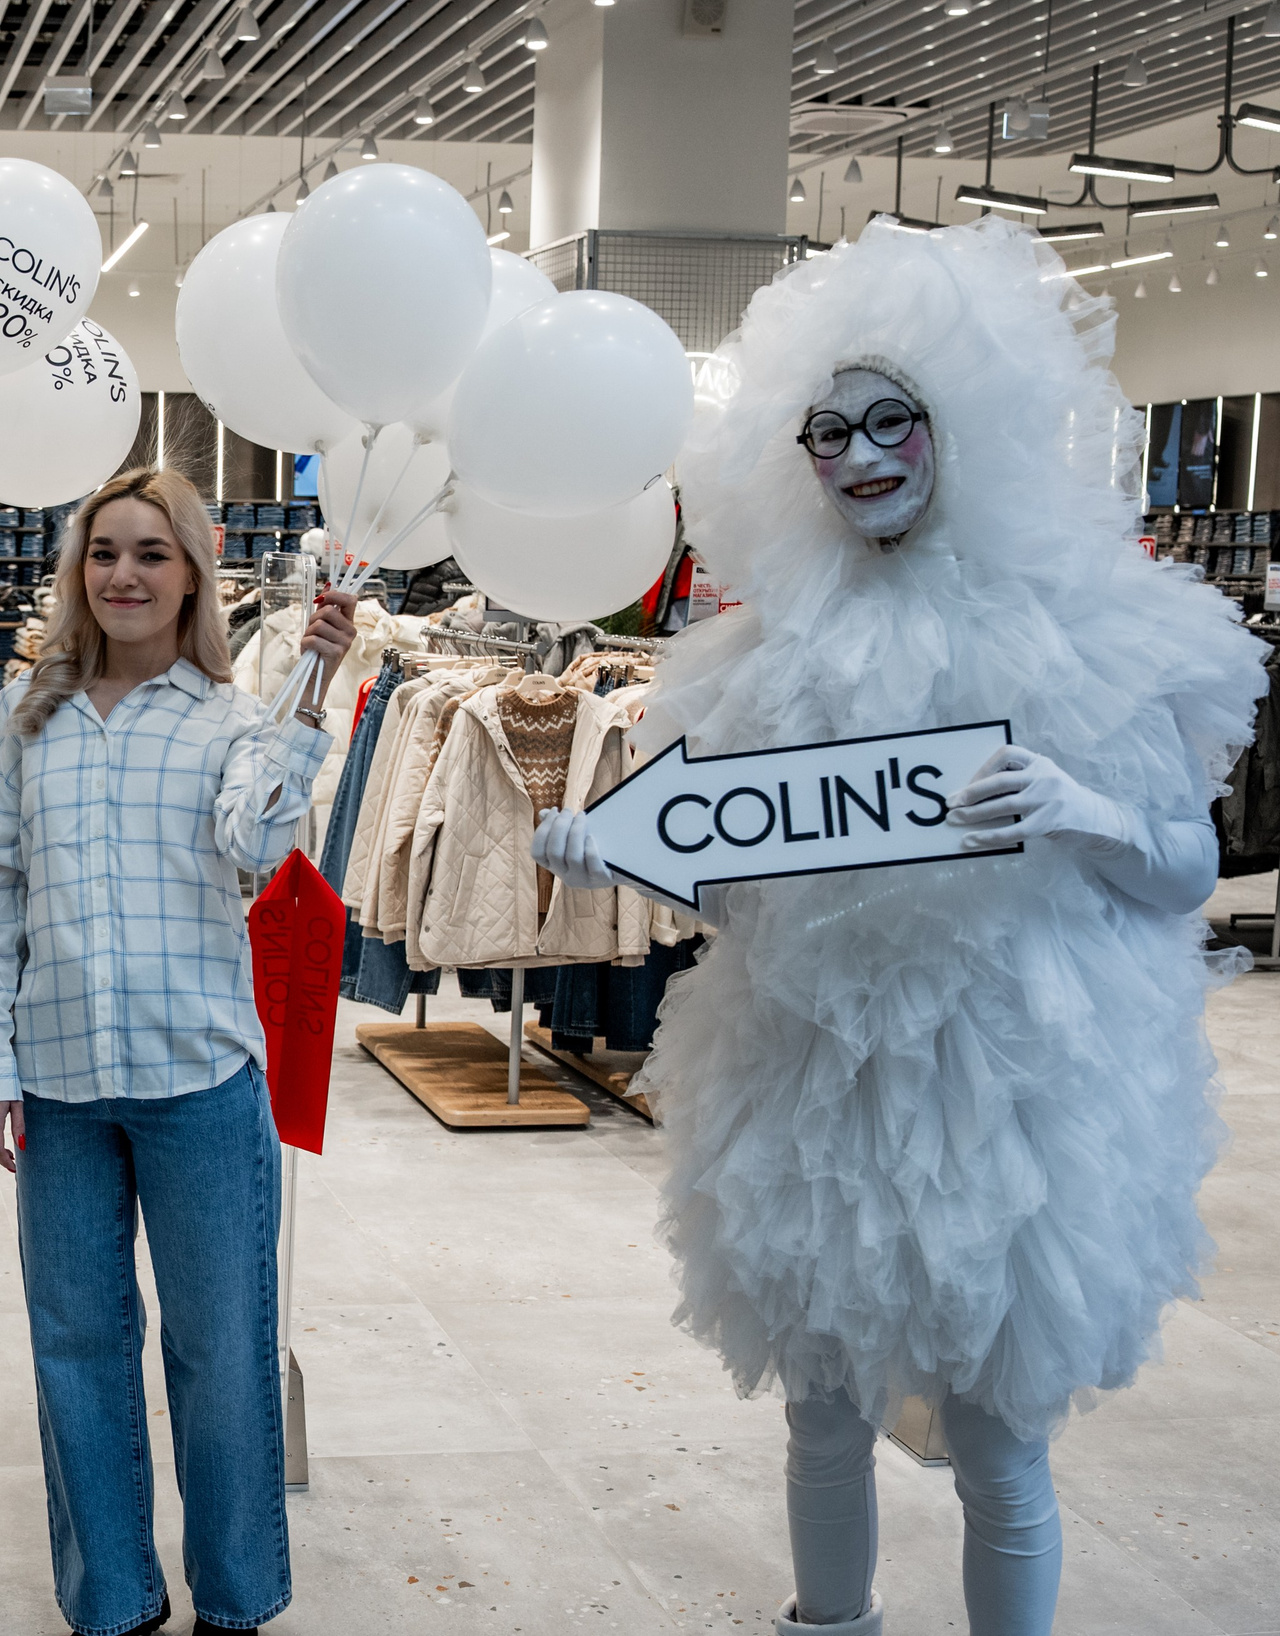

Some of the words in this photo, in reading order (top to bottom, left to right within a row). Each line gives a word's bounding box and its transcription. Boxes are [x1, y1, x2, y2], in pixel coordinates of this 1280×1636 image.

[44, 345, 74, 390] 0%
[70, 333, 98, 385] ИДКА
[81, 319, 127, 402] OLIN'S
[656, 757, 949, 854] COLIN'S
